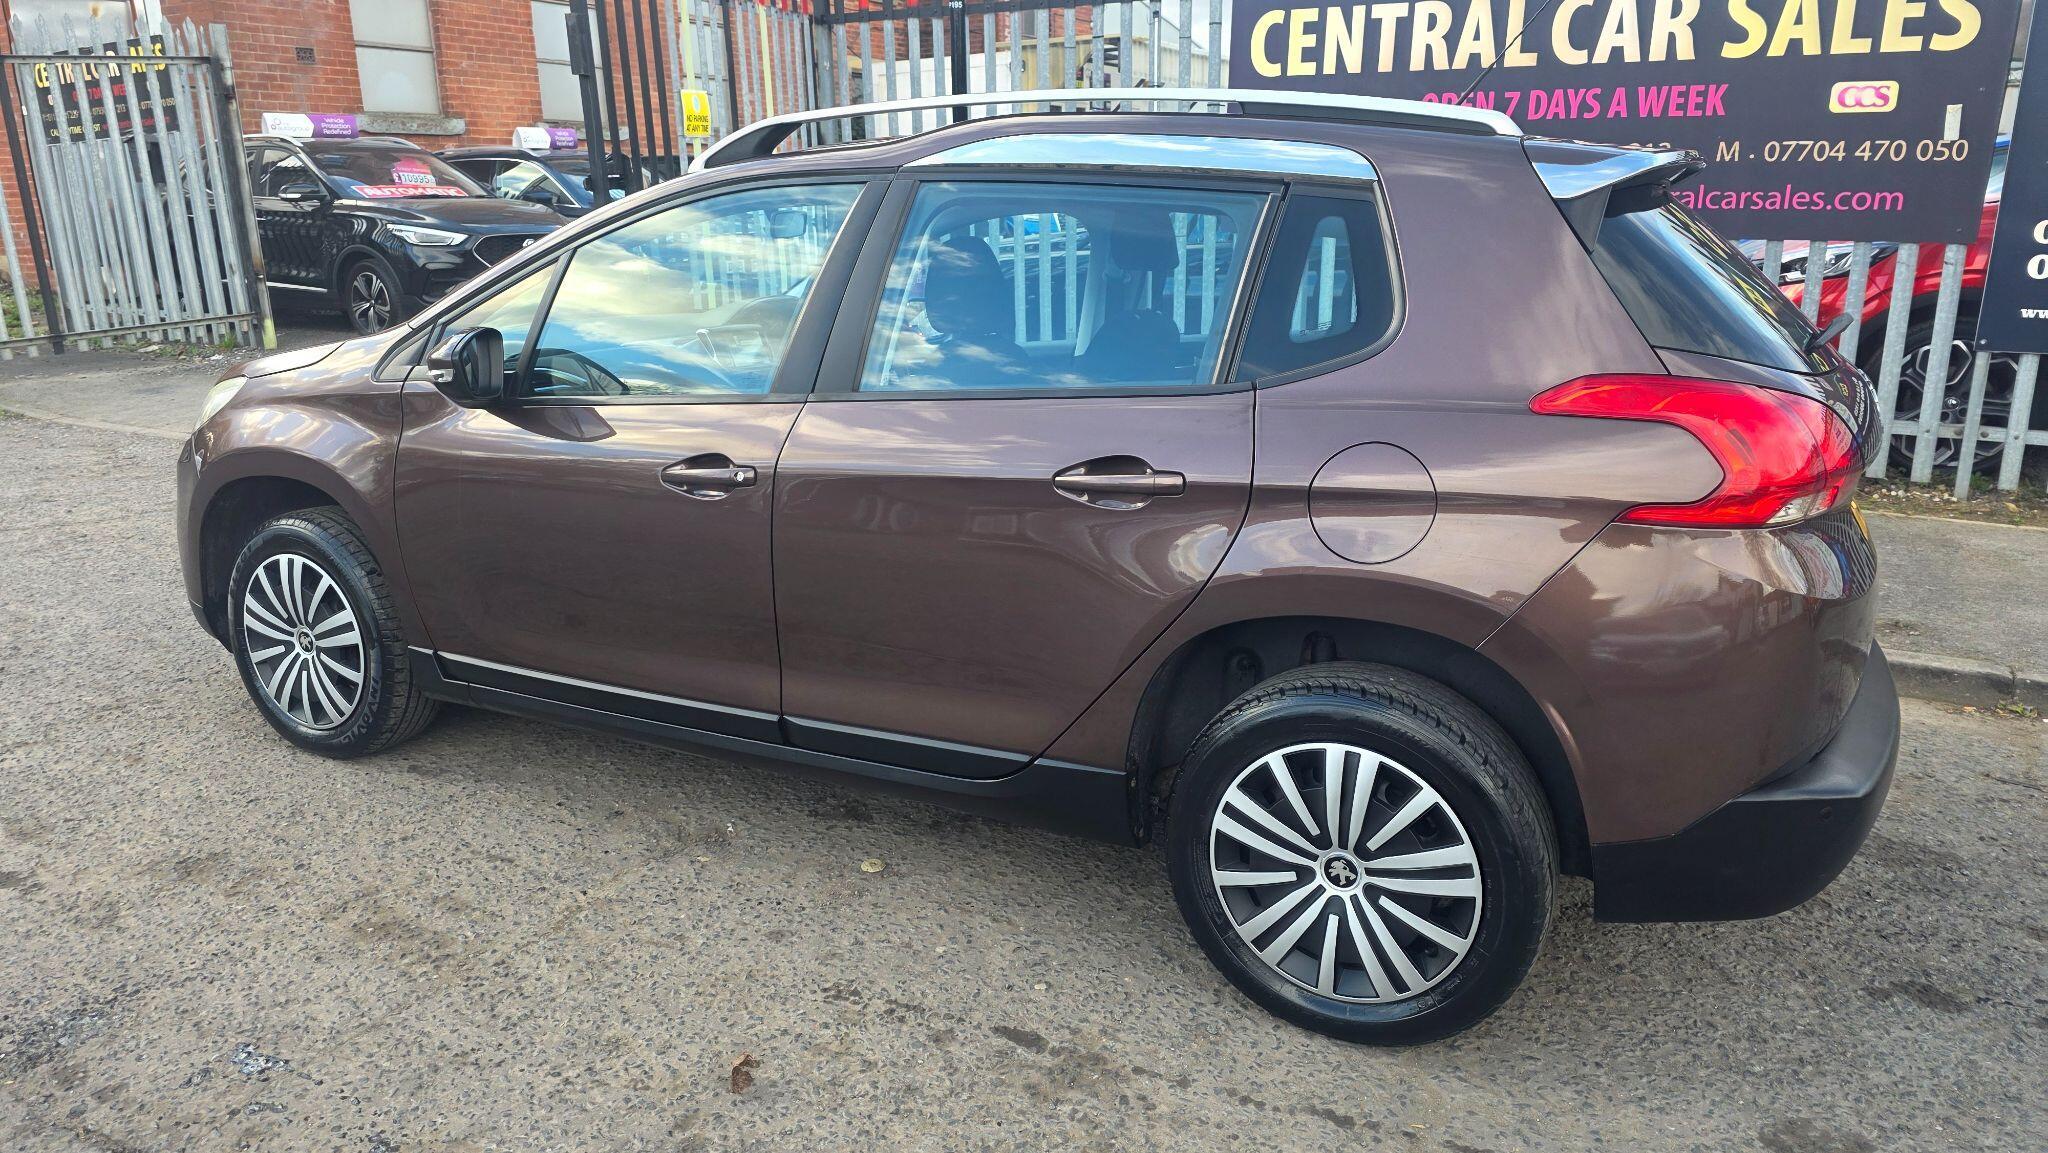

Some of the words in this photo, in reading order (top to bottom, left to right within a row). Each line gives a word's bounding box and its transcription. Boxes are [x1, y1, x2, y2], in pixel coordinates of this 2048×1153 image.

[1250, 0, 1539, 77] CENTRAL
[1551, 0, 1701, 65] CAR
[1720, 0, 1982, 59] SALES
[1504, 91, 1521, 117] 7
[1527, 87, 1602, 120] DAYS
[1606, 88, 1629, 118] A
[1637, 83, 1730, 118] WEEK
[1837, 85, 1891, 108] CCS
[1715, 141, 1740, 162] M
[1764, 140, 1846, 162] 07704
[1854, 140, 1907, 162] 470
[1915, 139, 1970, 162] 050
[361, 186, 461, 197] AUTOMATIC
